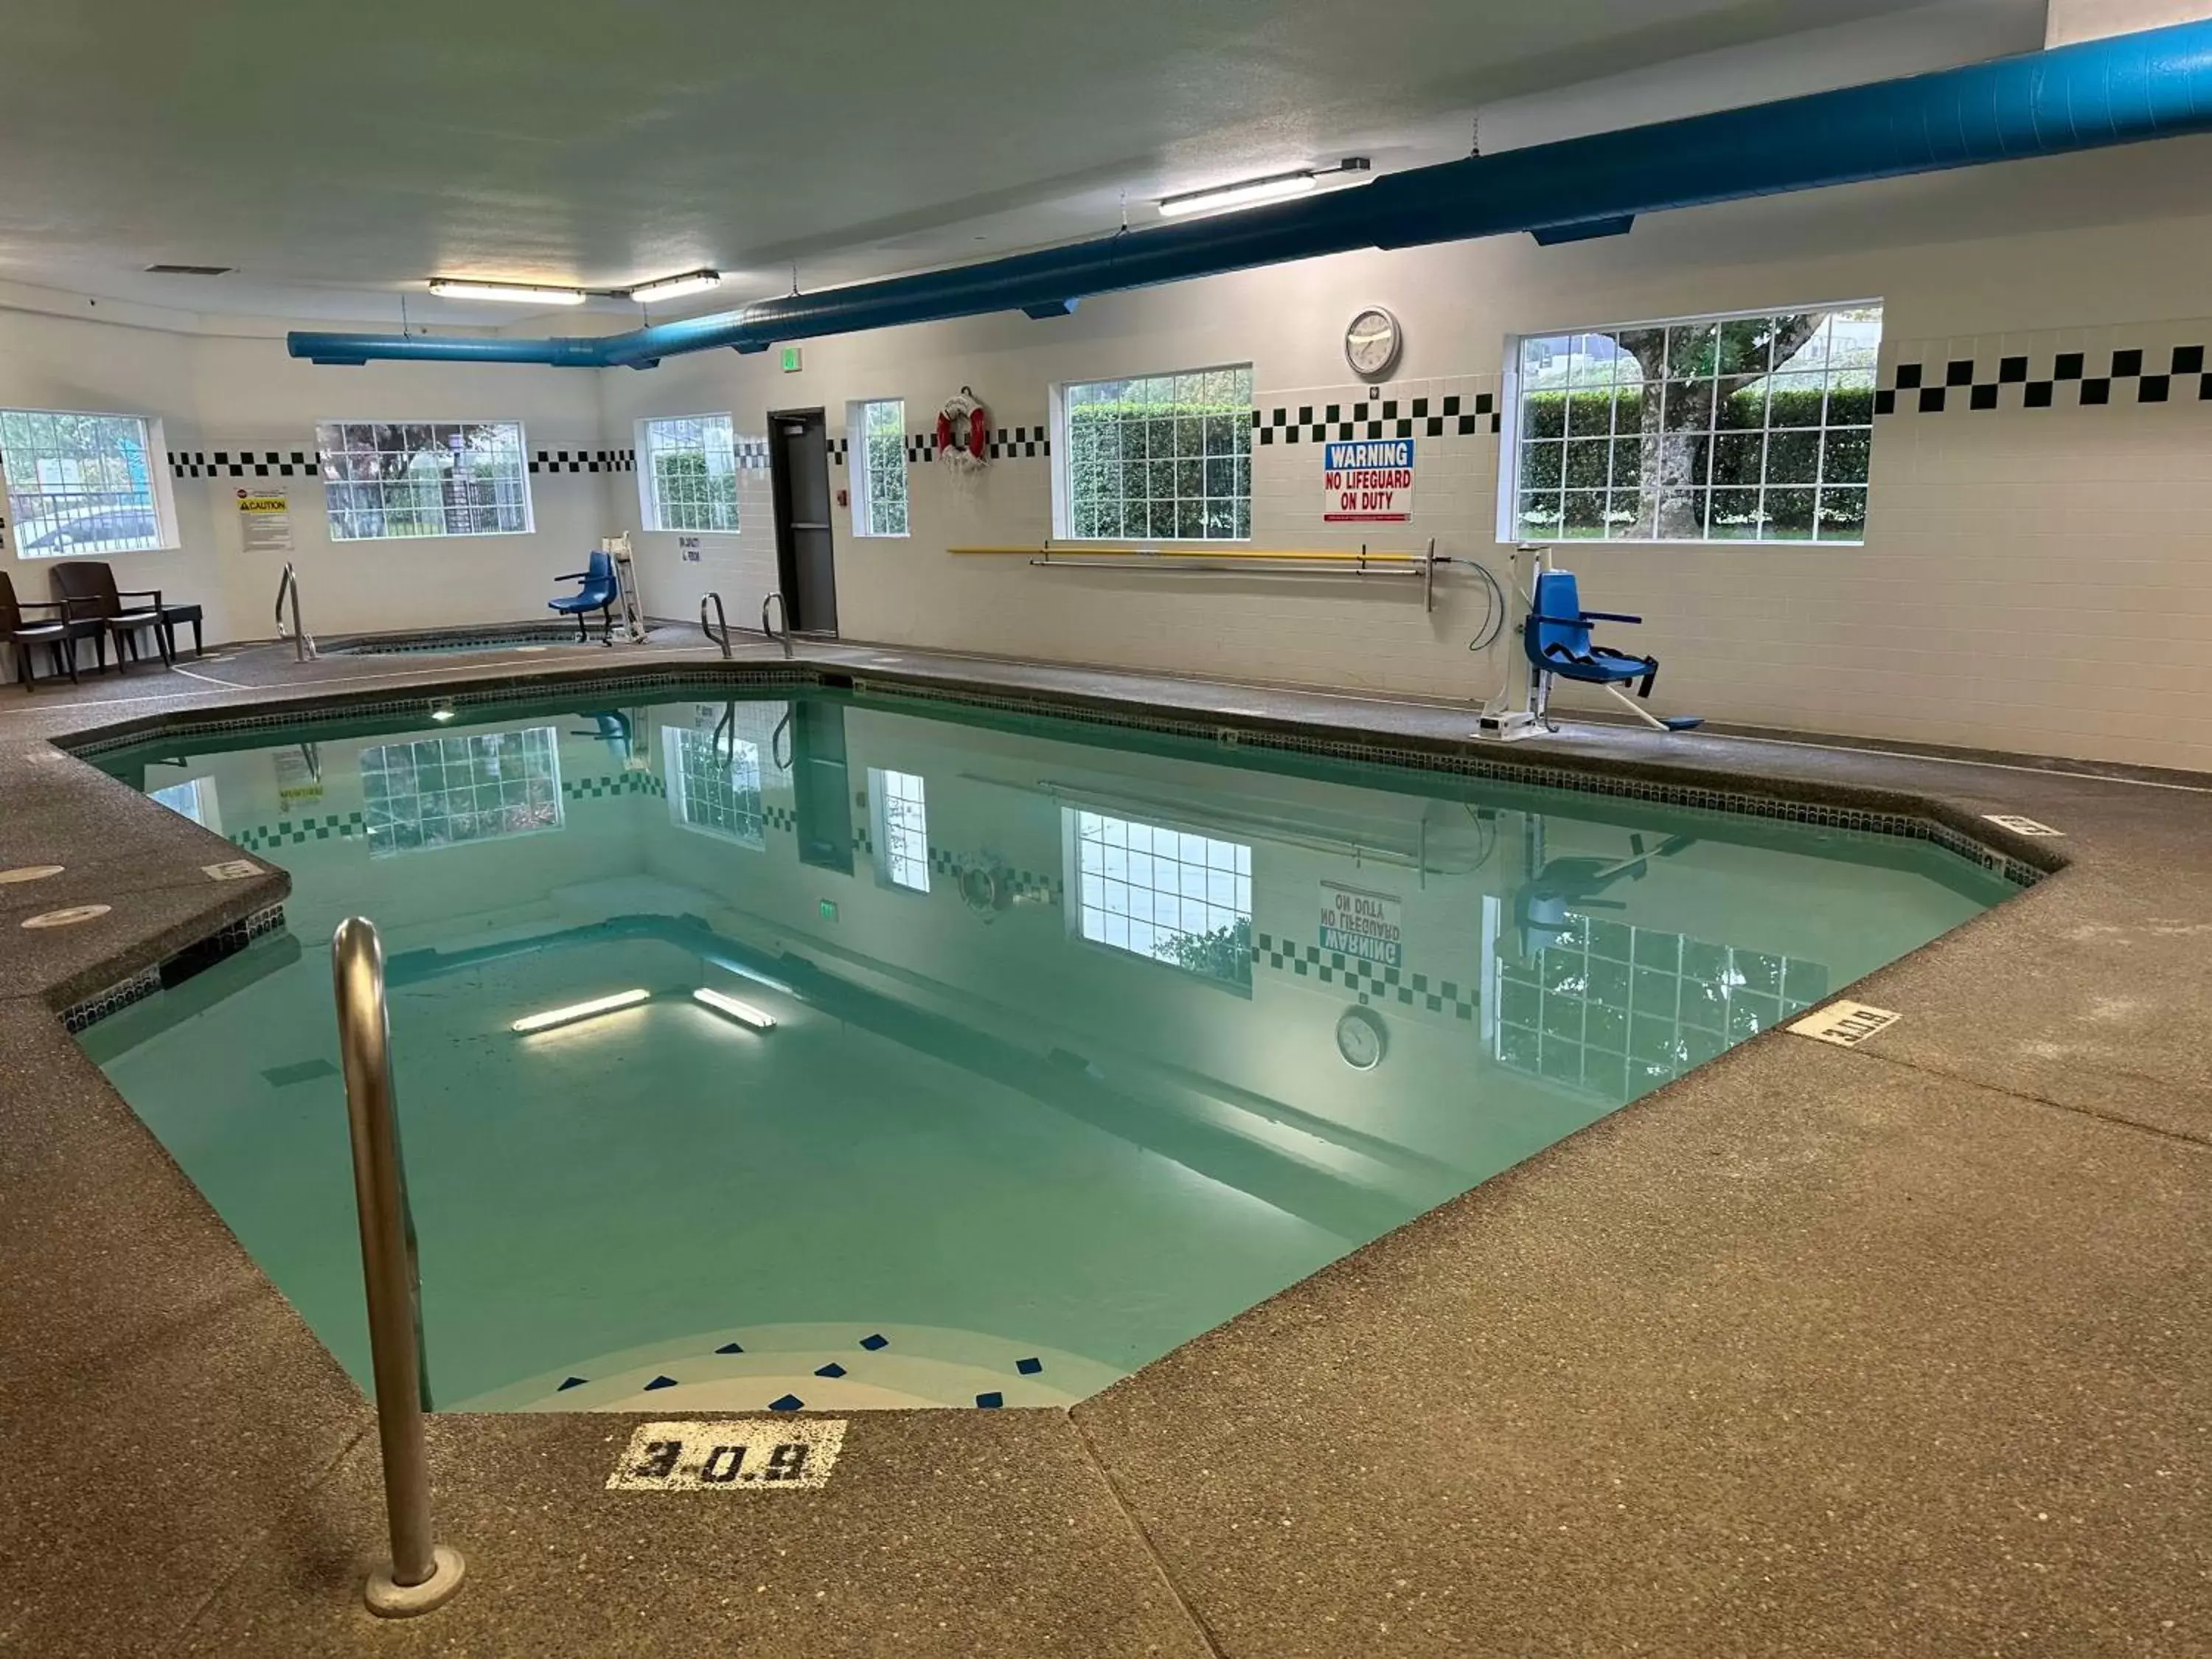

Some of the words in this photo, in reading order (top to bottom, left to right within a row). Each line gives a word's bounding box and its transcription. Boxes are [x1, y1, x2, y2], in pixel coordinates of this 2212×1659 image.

[1331, 442, 1408, 468] WARNING
[1325, 472, 1341, 490] NO
[1346, 470, 1411, 490] LIFEGUARD
[250, 501, 285, 510] CAUTION
[1340, 492, 1356, 510] ON
[1362, 491, 1393, 510] DUTY
